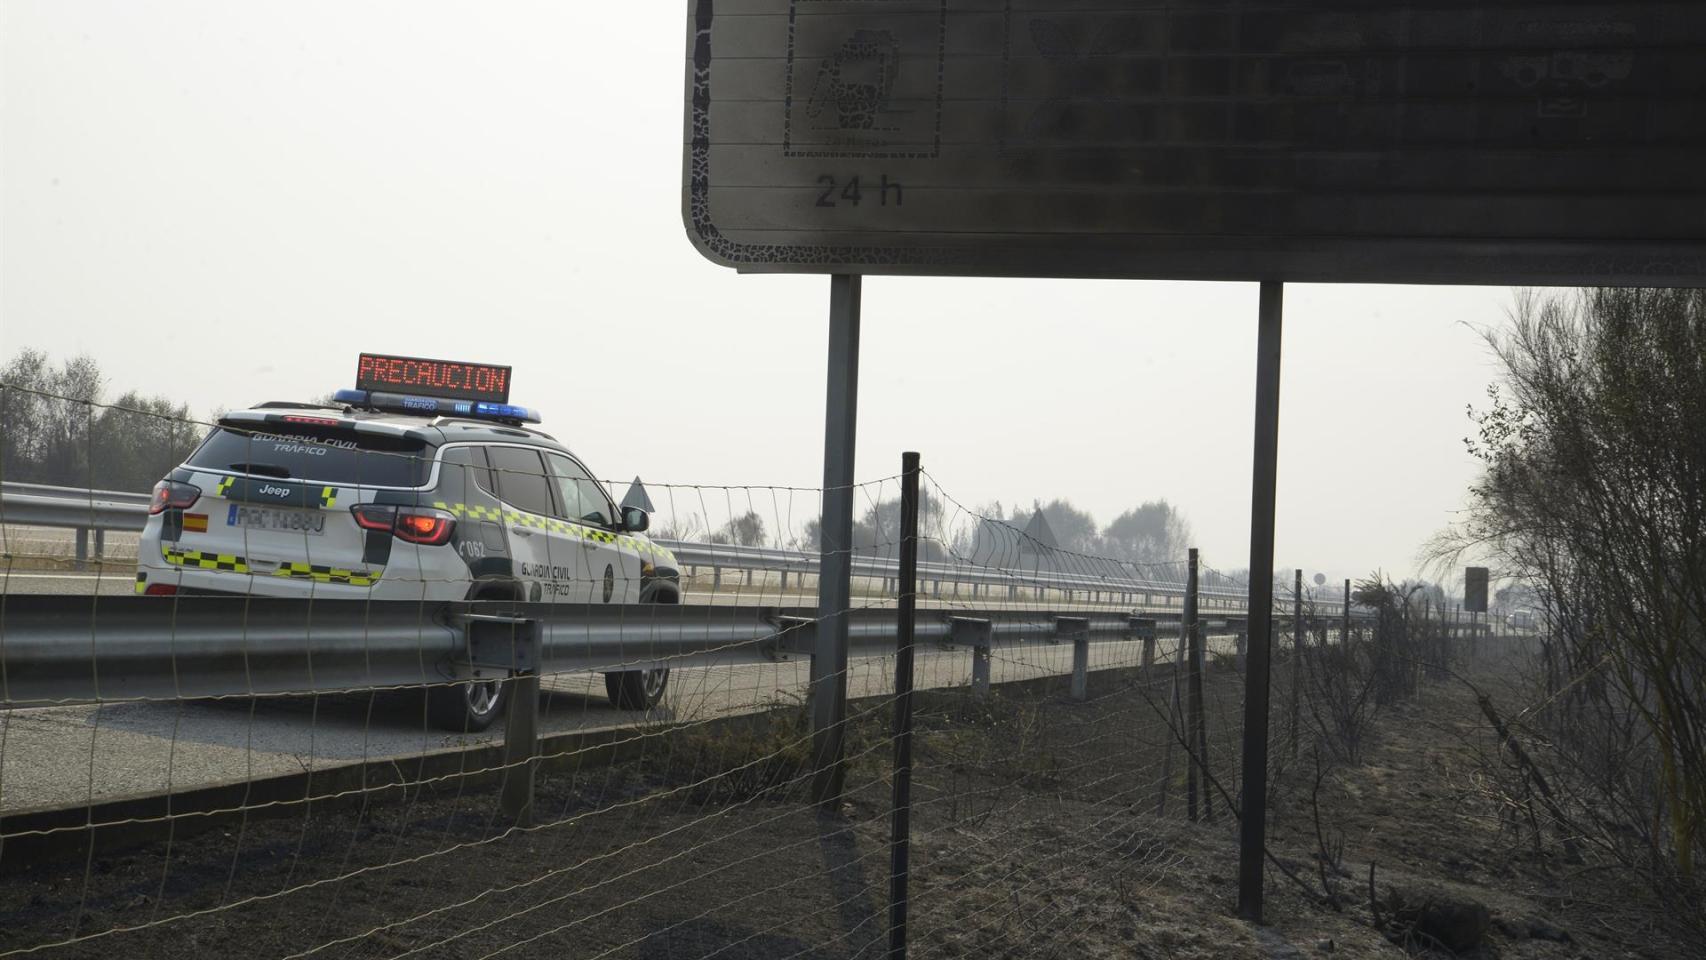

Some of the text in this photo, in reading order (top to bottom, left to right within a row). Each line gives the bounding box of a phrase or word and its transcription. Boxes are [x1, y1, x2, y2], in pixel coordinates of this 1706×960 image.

[816, 173, 903, 208] 24 h
[359, 356, 507, 393] PRECAUCION
[252, 433, 358, 450] GUARDIA CIVIL
[259, 484, 290, 497] Jeep
[467, 541, 486, 557] 062
[552, 566, 570, 580] CIVIL
